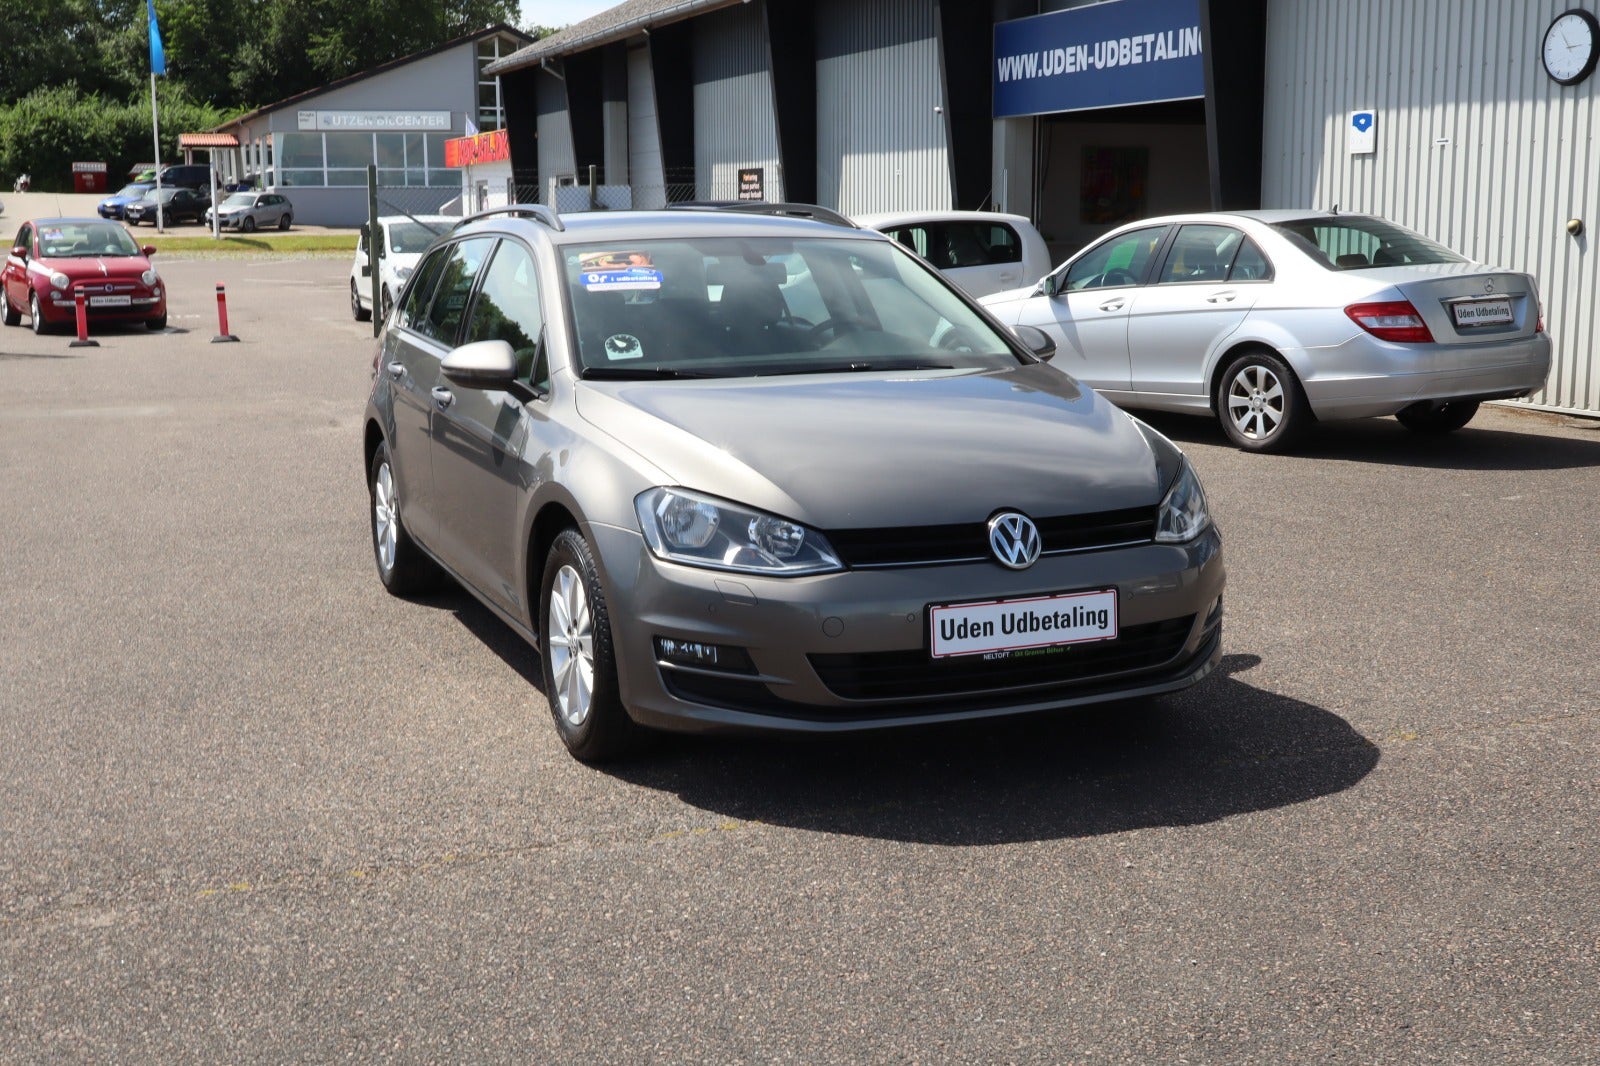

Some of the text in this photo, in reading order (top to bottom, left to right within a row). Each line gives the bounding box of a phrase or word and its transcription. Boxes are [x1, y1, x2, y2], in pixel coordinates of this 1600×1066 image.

[998, 26, 1202, 82] WWW.UDEN-UDBETALIN
[1457, 306, 1510, 318] Uden Udbetaling
[940, 605, 1108, 641] Uden Udbetaling
[983, 651, 1010, 660] NELTOFT
